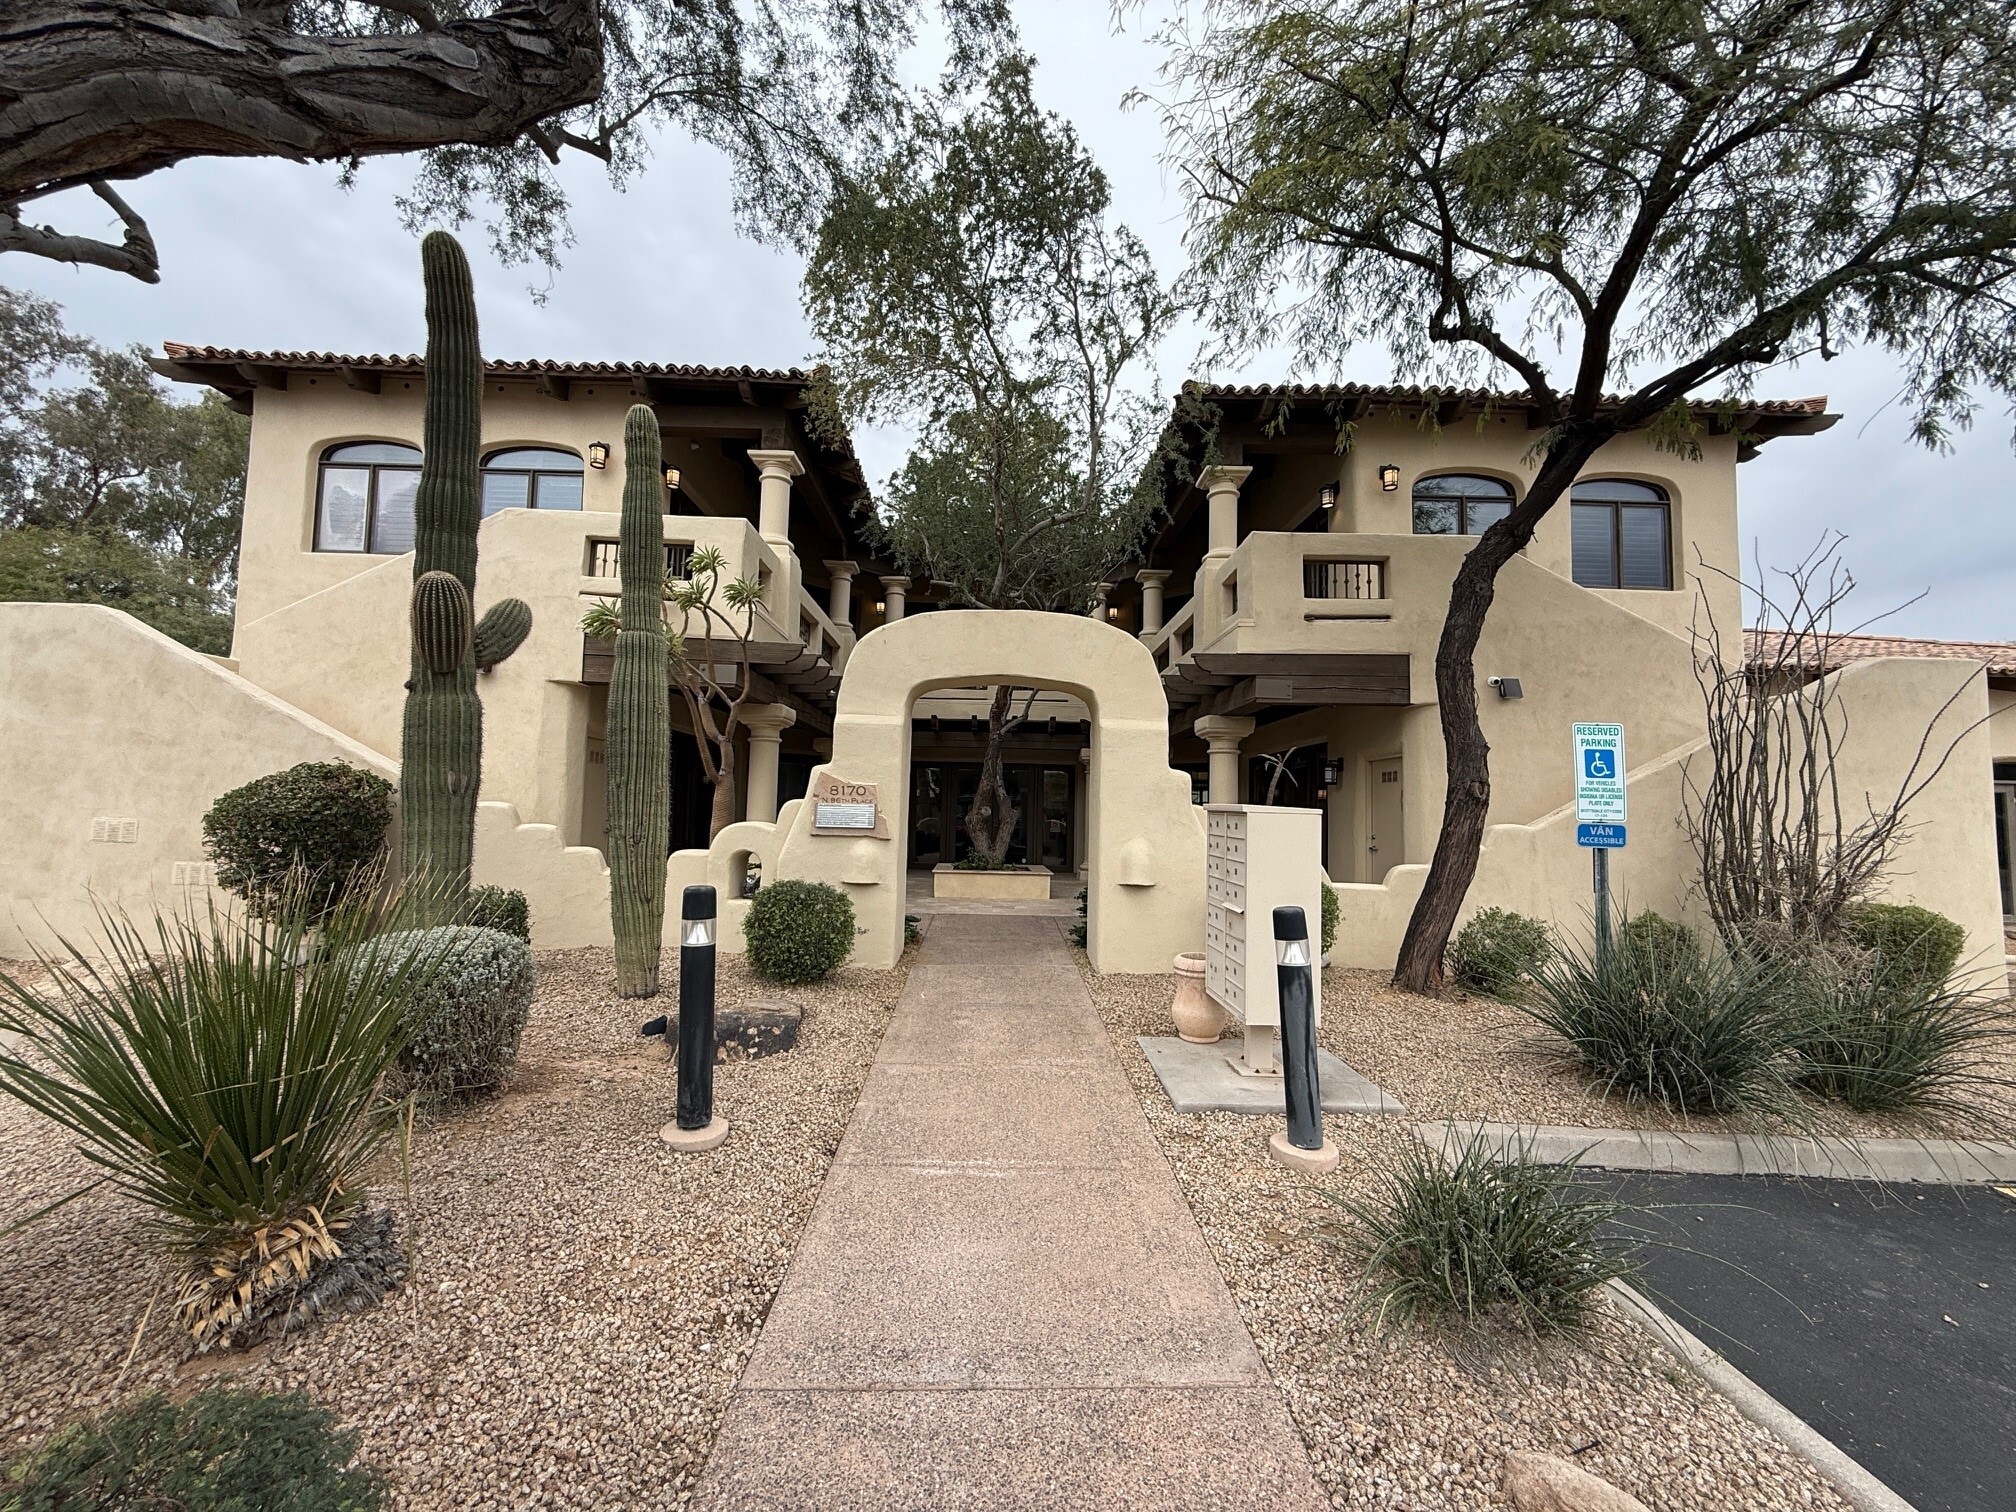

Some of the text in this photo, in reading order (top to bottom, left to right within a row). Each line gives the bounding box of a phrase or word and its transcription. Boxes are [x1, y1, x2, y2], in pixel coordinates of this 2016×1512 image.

[1576, 727, 1619, 736] RESERVED
[1580, 738, 1617, 747] PARKING
[829, 785, 866, 796] 8170
[1590, 826, 1613, 836] VAN
[1579, 836, 1625, 845] ACCESSIBLE
